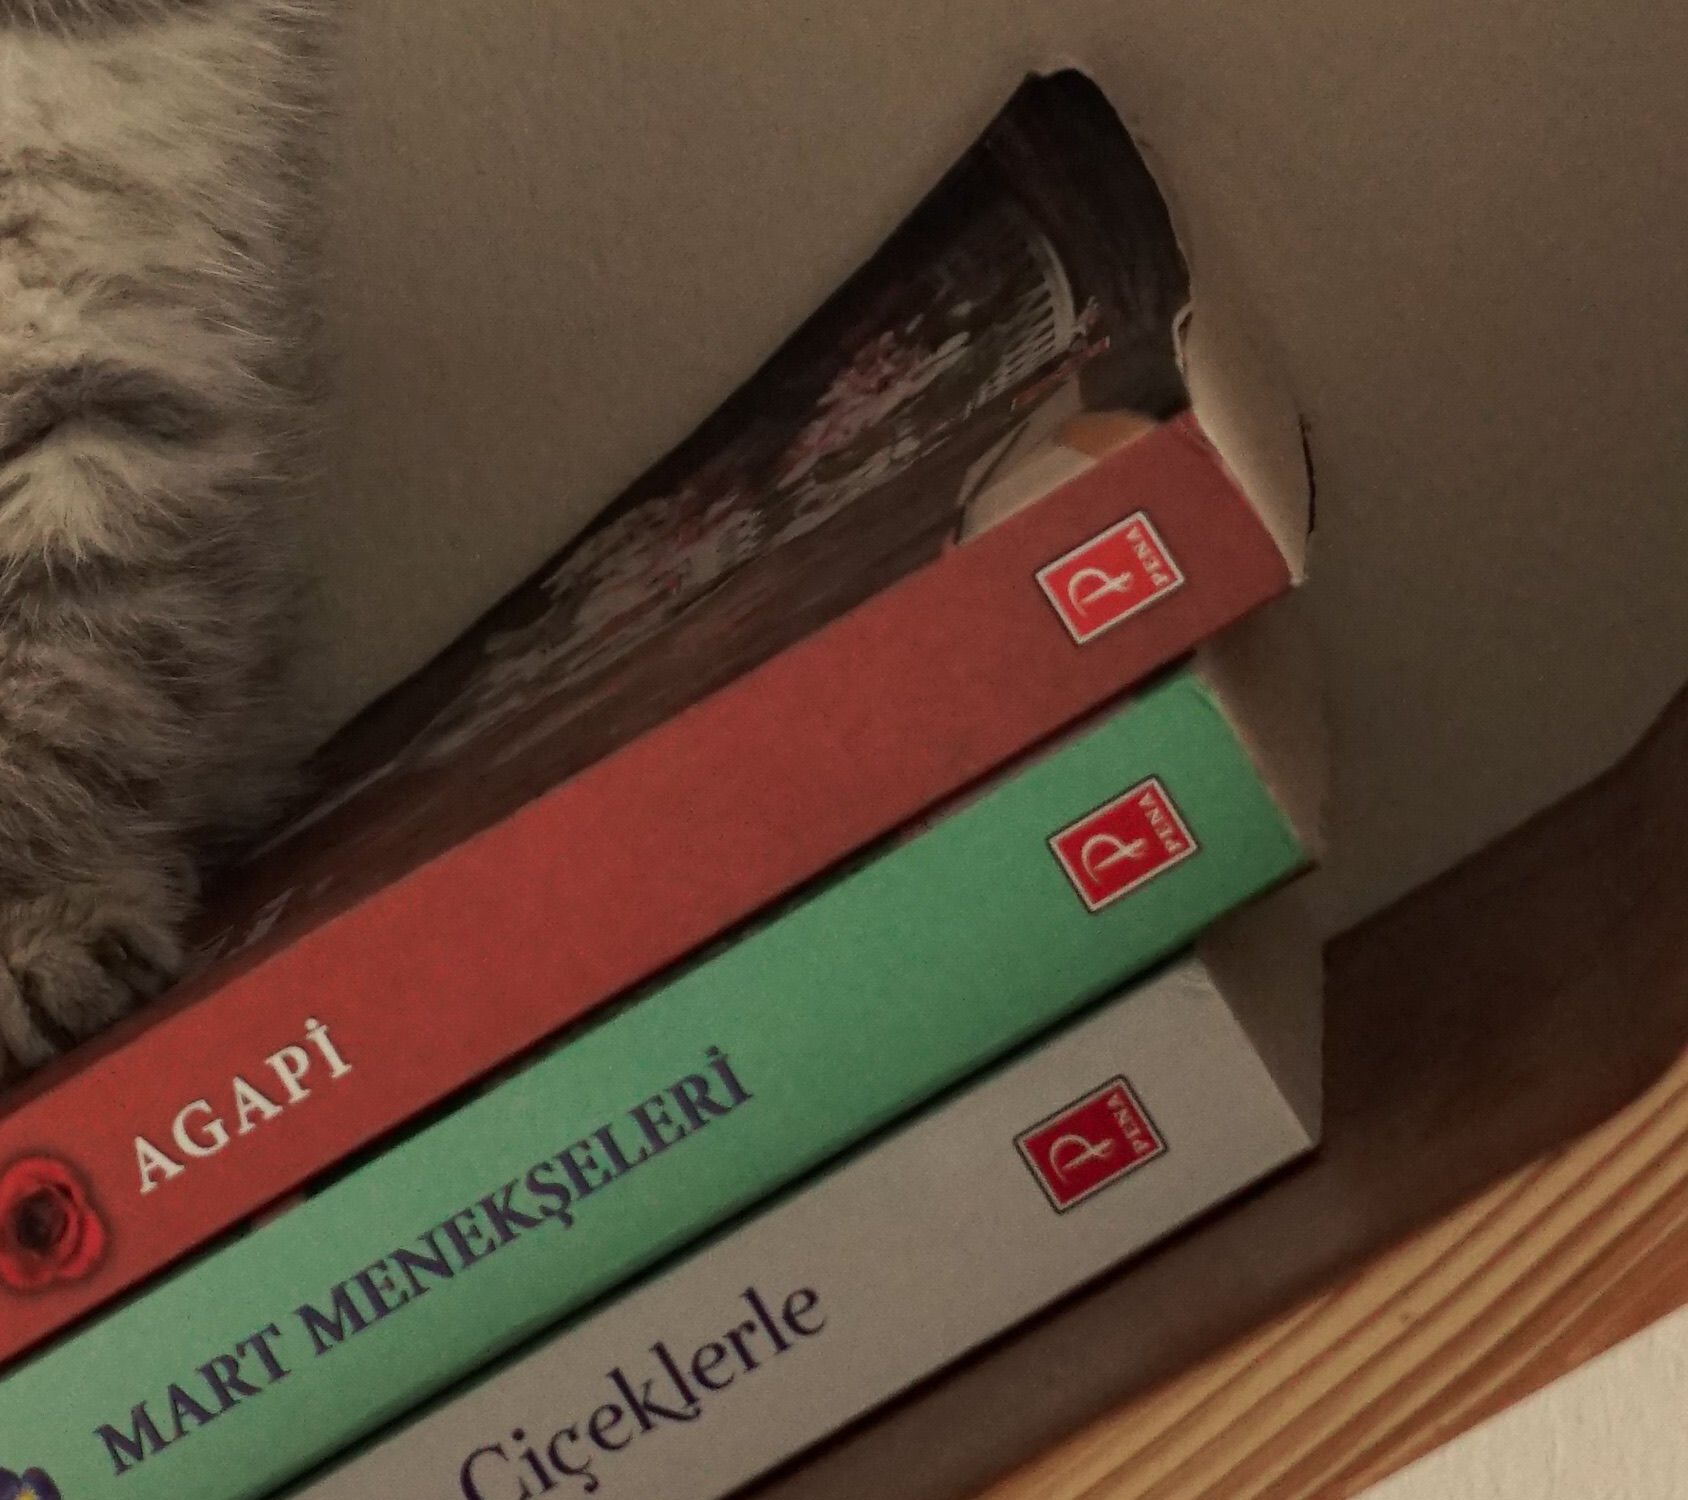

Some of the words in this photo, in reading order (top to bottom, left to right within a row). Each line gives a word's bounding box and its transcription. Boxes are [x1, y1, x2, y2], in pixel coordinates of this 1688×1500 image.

[1125, 524, 1170, 587] PENA
[1138, 791, 1183, 854] PENA
[131, 1018, 353, 1195] AGAPİ
[1107, 1093, 1151, 1155] PENA
[94, 1325, 292, 1477] MART
[295, 1046, 754, 1357] MENEKŞELERİ
